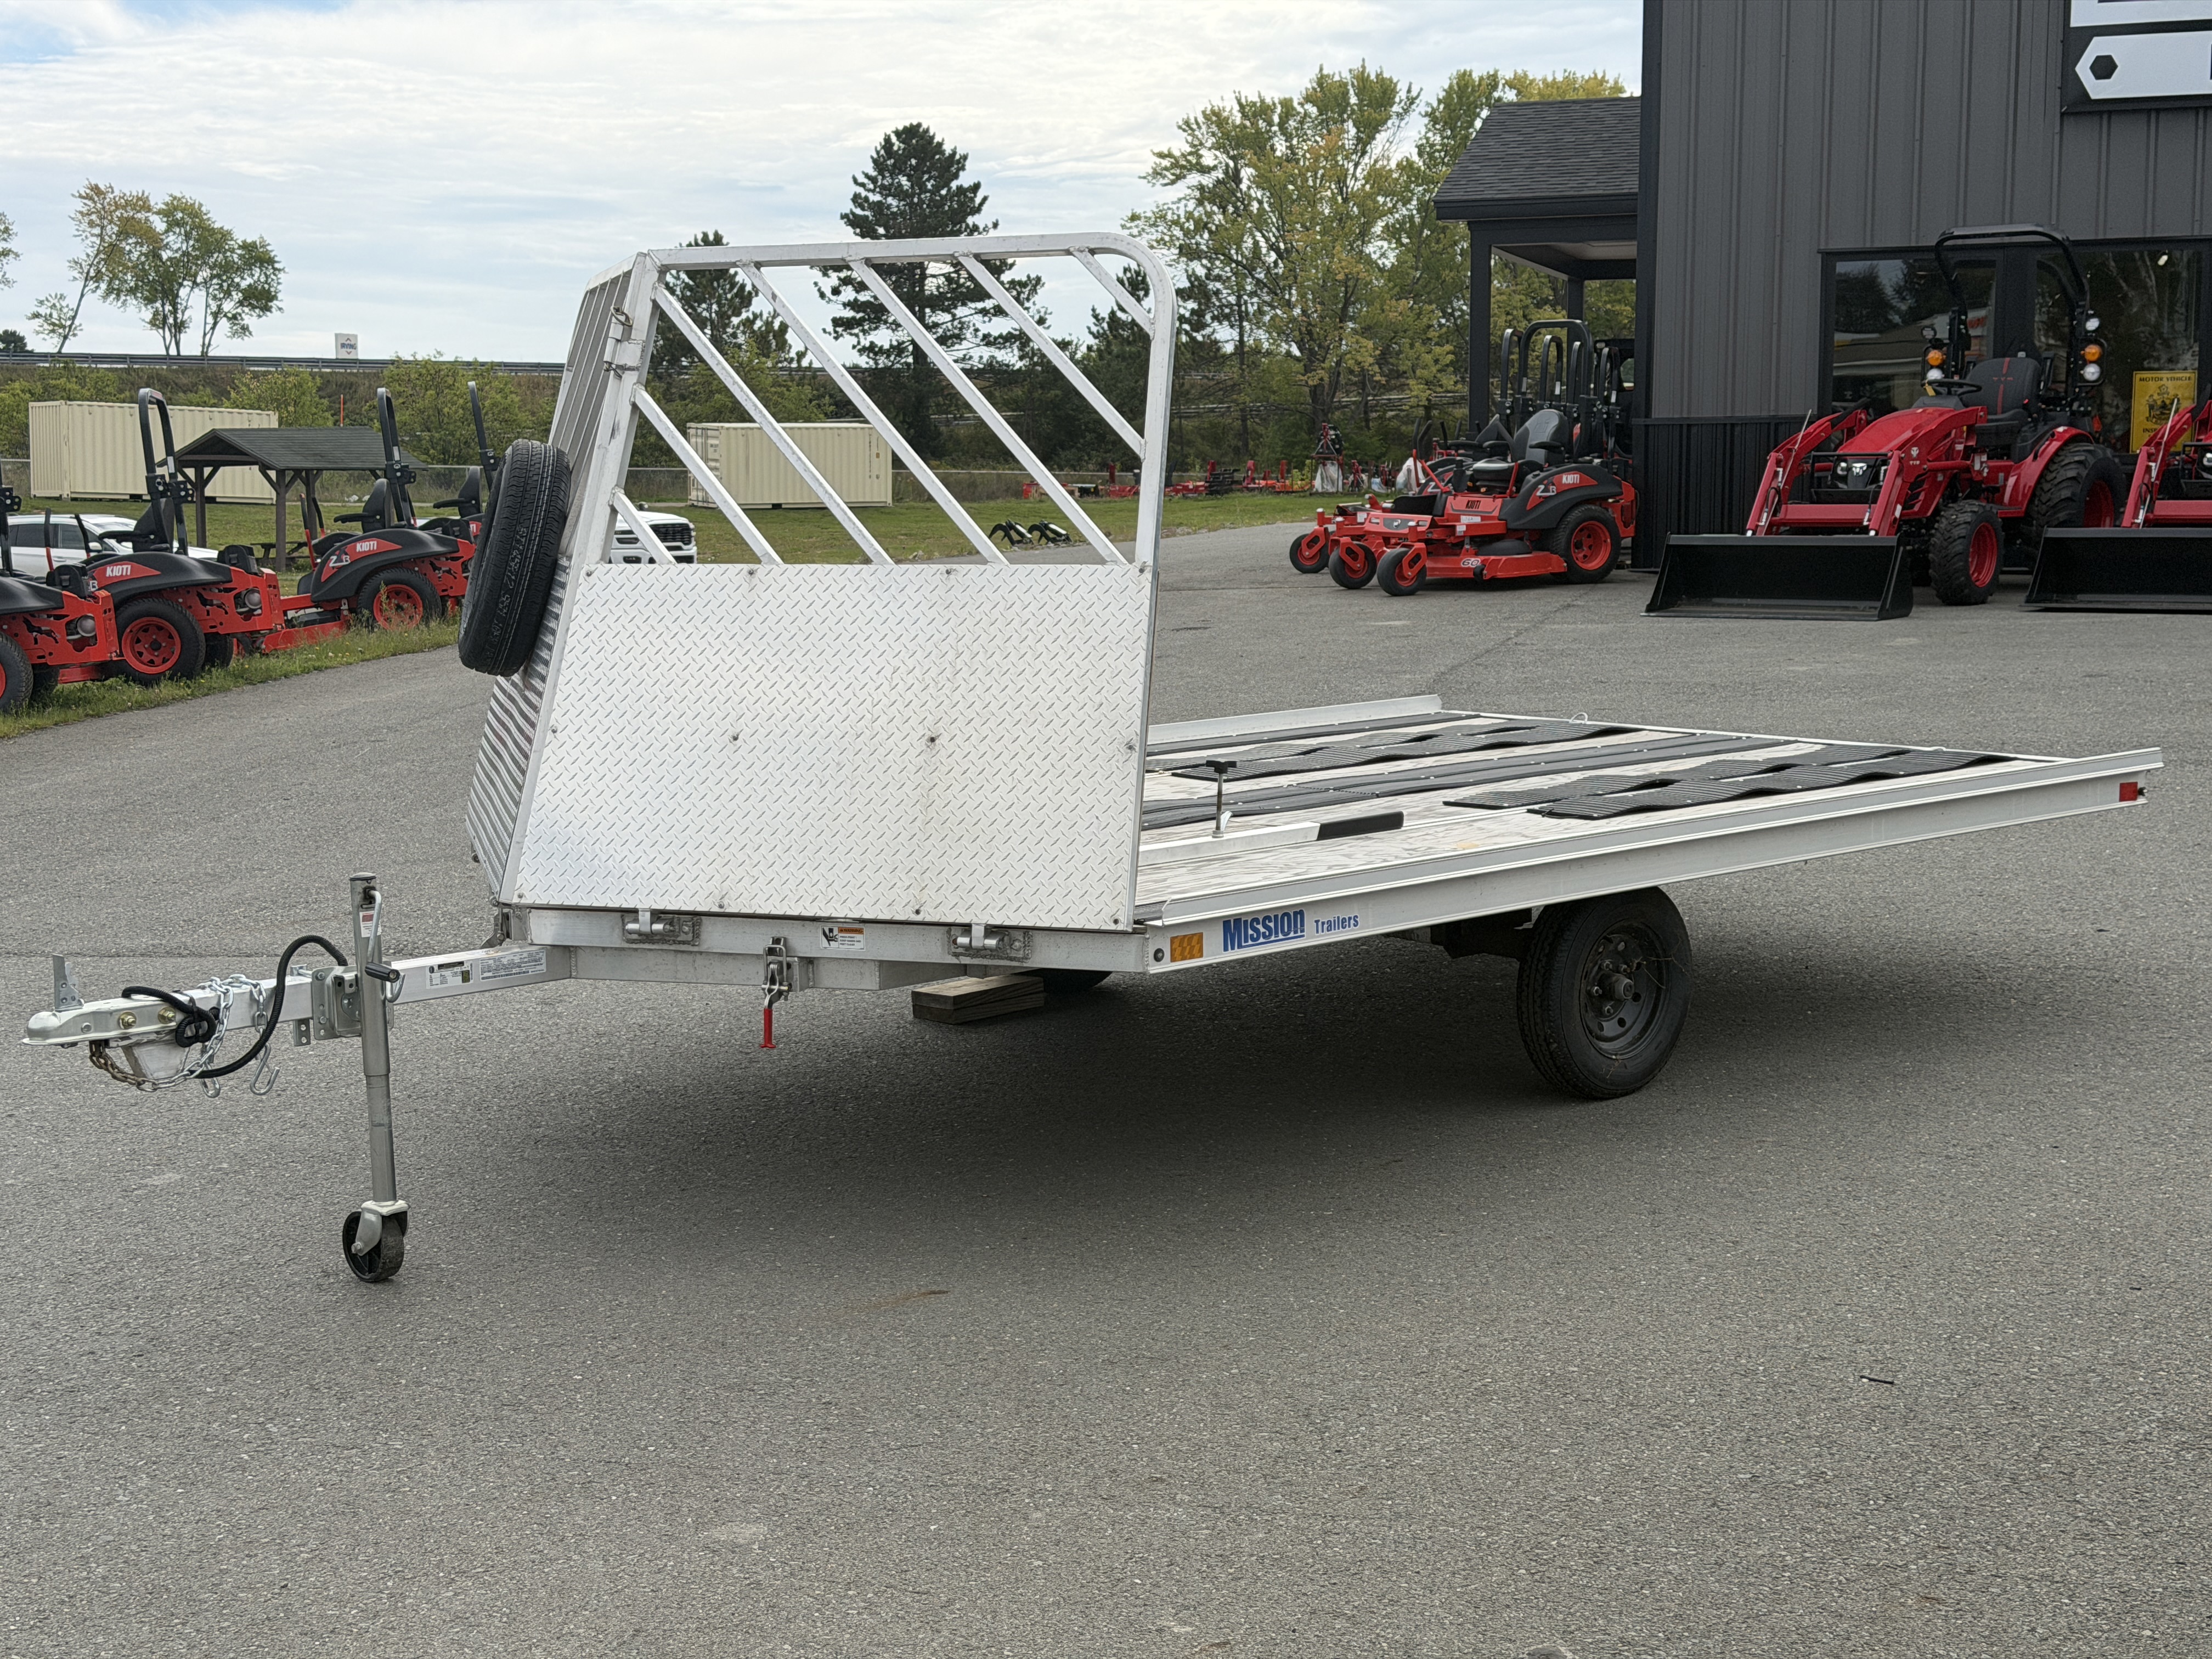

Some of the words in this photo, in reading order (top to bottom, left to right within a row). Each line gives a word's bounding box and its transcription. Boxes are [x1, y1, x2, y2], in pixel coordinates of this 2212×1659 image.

[1562, 474, 1580, 484] KIOTI
[1465, 500, 1481, 509] KIOTI
[357, 541, 377, 552] KIOTI
[1462, 558, 1480, 567] 60
[106, 565, 131, 577] KIOTI
[1314, 915, 1359, 934] Trailers
